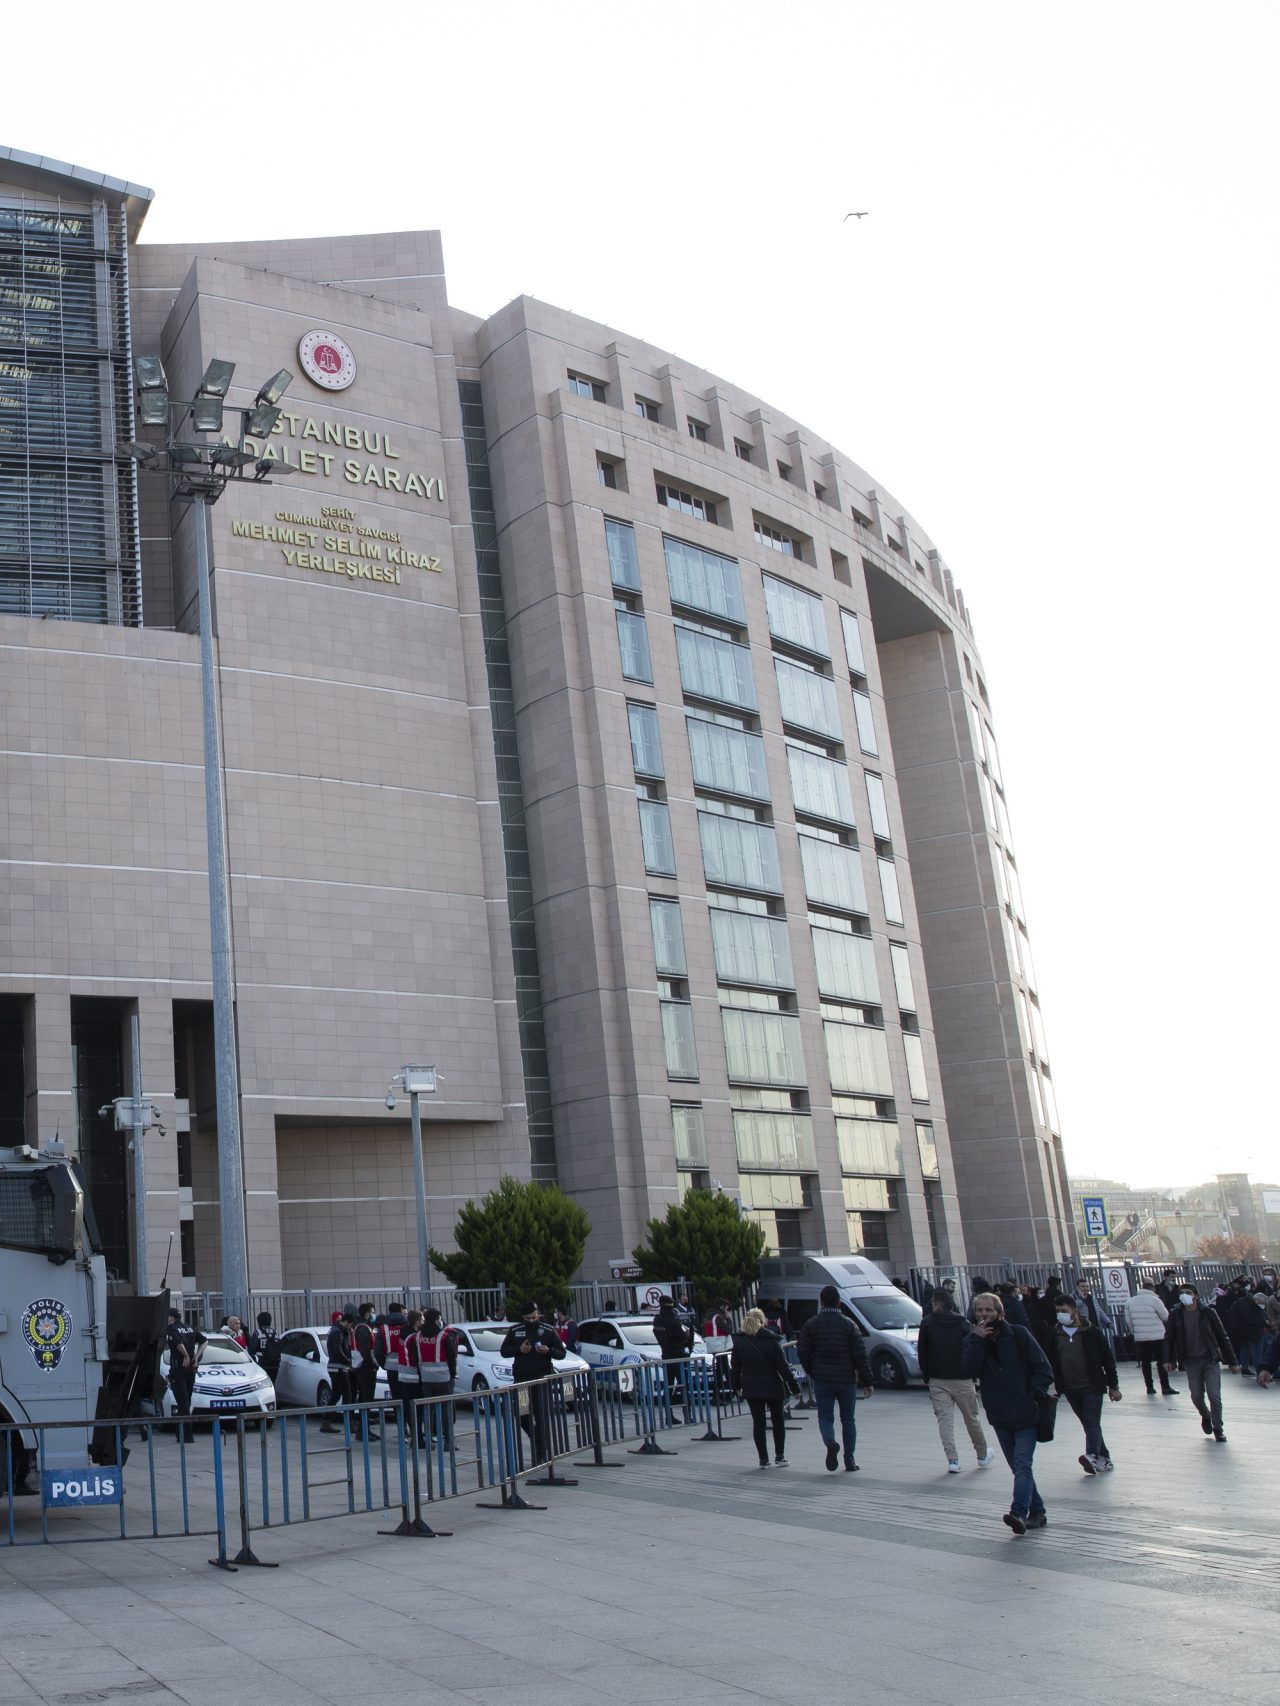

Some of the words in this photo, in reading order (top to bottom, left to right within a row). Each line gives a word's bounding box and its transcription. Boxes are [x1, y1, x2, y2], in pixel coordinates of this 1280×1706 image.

[271, 412, 400, 459] STANBUL
[344, 458, 445, 501] SARAYI
[232, 519, 319, 548] MEHMET
[324, 535, 382, 560] SELİM
[387, 546, 443, 573] KİRAZ
[281, 549, 401, 585] YERLEŞKESİ
[32, 1300, 61, 1311] POLİS
[52, 1476, 115, 1498] POLİS
